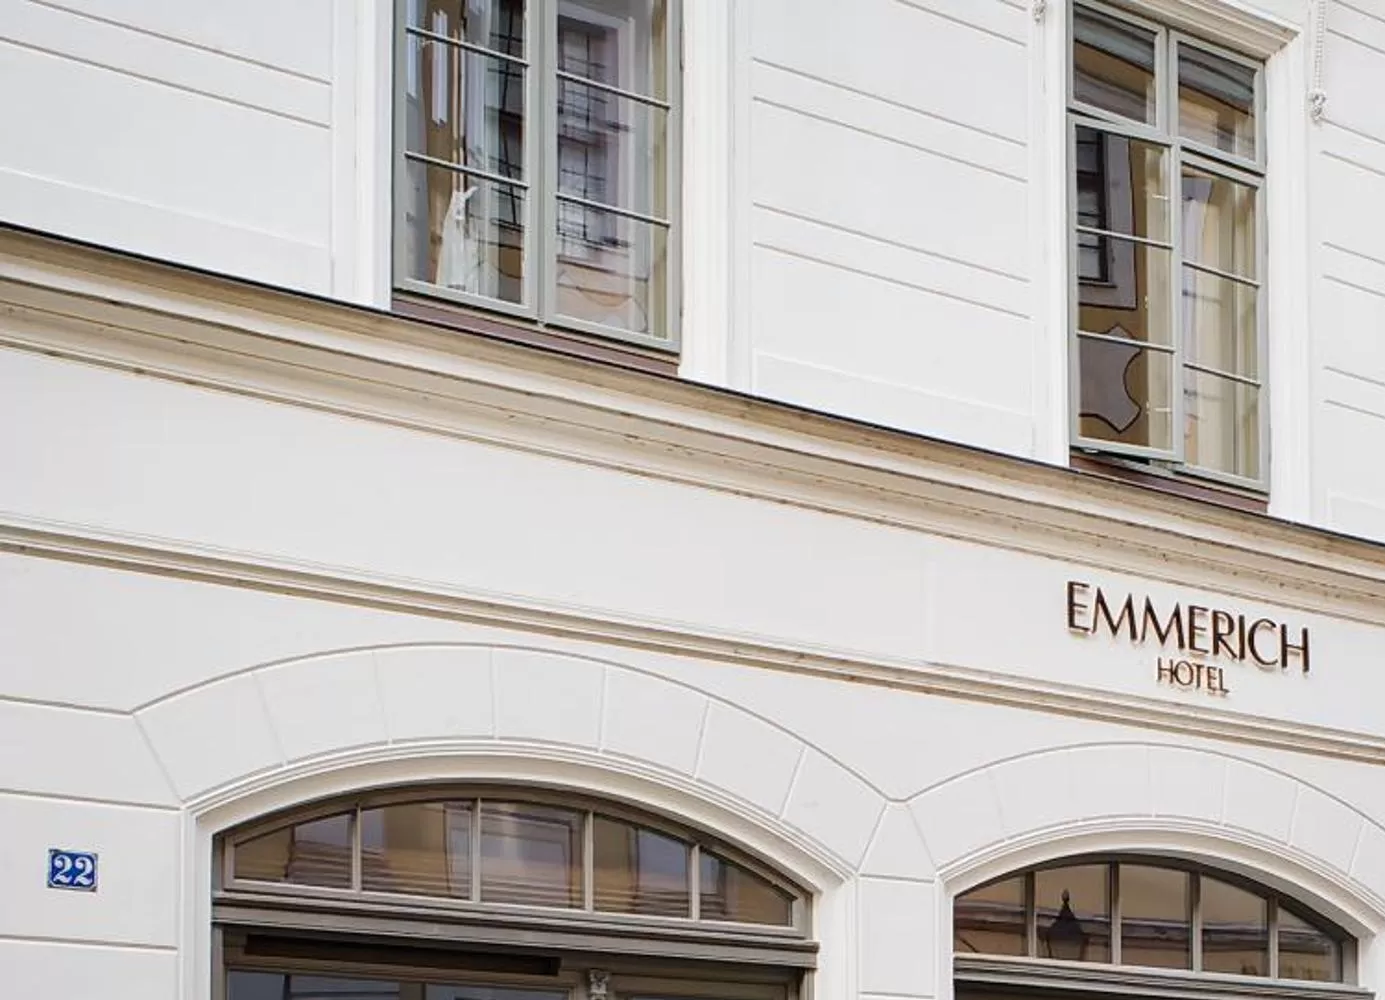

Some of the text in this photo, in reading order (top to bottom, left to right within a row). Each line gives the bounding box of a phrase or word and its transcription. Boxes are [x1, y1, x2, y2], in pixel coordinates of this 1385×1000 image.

[1067, 581, 1310, 673] EMMERICH
[1157, 657, 1230, 693] HOTEL
[53, 855, 93, 885] 22
